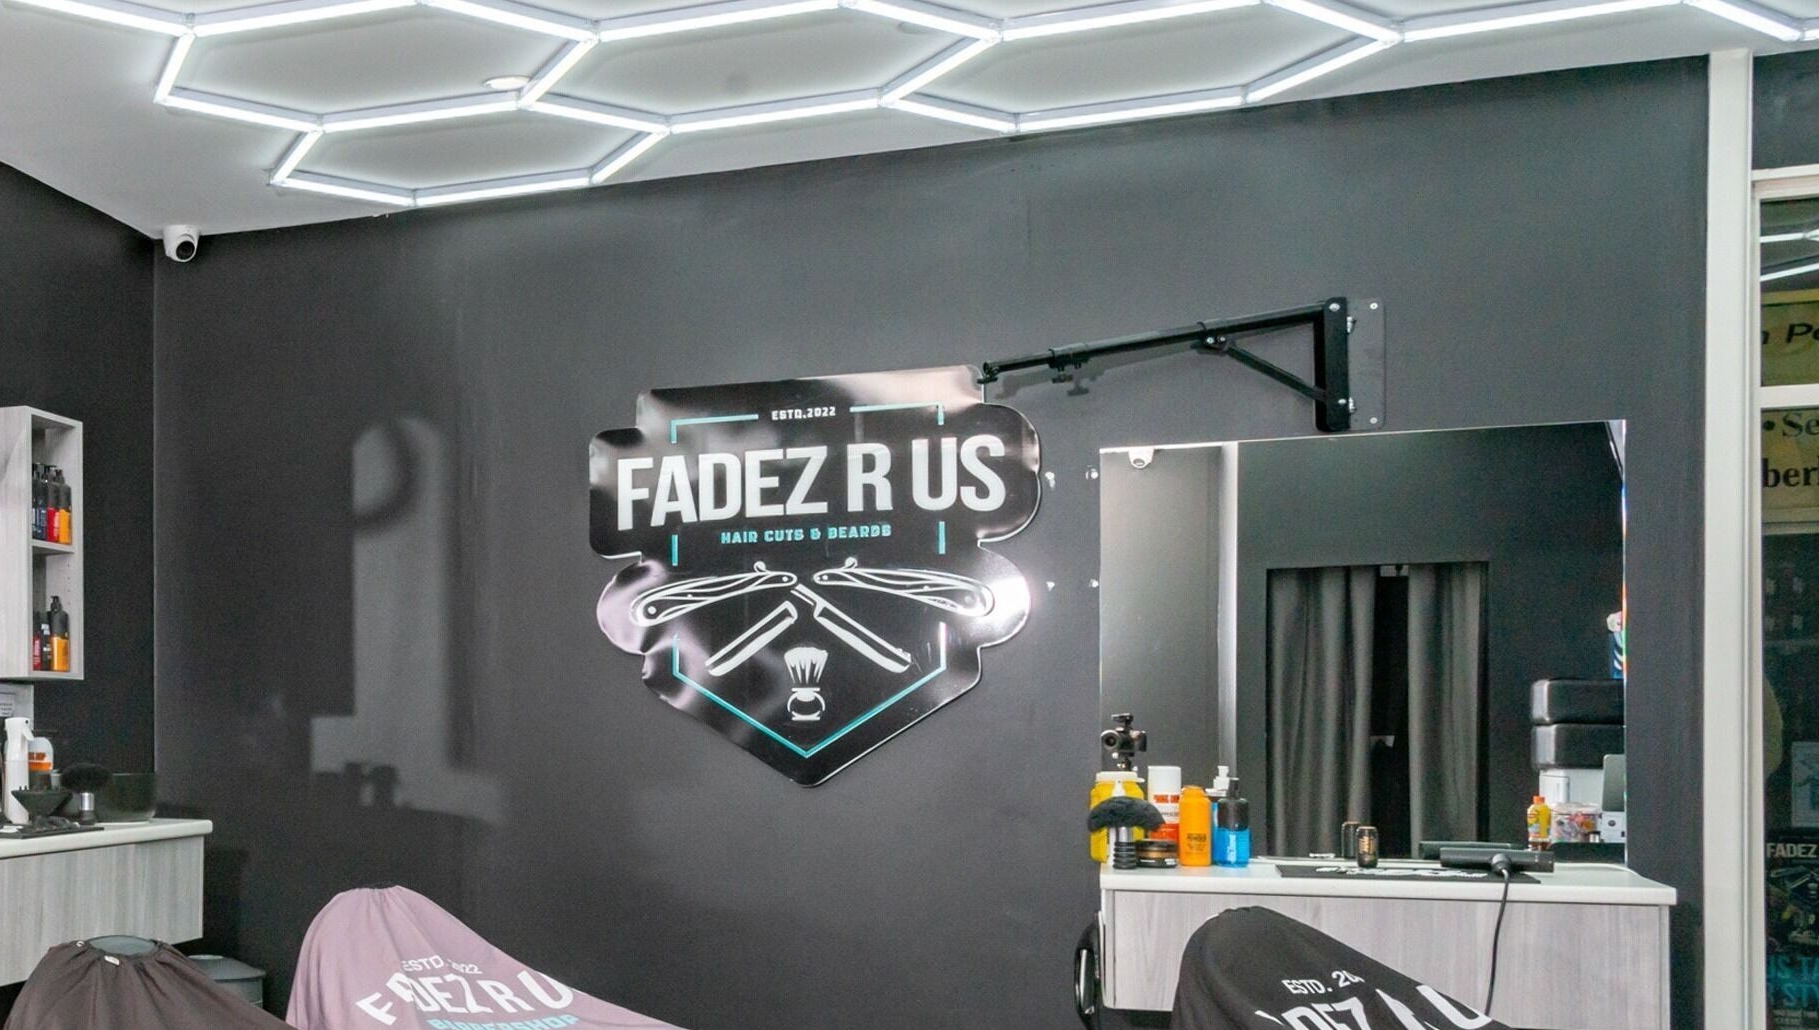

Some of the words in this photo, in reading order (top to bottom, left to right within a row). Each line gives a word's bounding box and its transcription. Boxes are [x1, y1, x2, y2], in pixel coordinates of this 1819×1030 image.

[617, 445, 828, 531] FADEZ
[847, 442, 893, 513] R
[911, 433, 1007, 512] US
[1762, 457, 1819, 488] ber
[720, 530, 758, 545] HAIR
[763, 527, 804, 543] CUTS
[827, 523, 892, 541] BEARDS
[1766, 843, 1818, 858] FADEZ
[476, 979, 535, 1013] R
[1282, 979, 1333, 995] ESTD.
